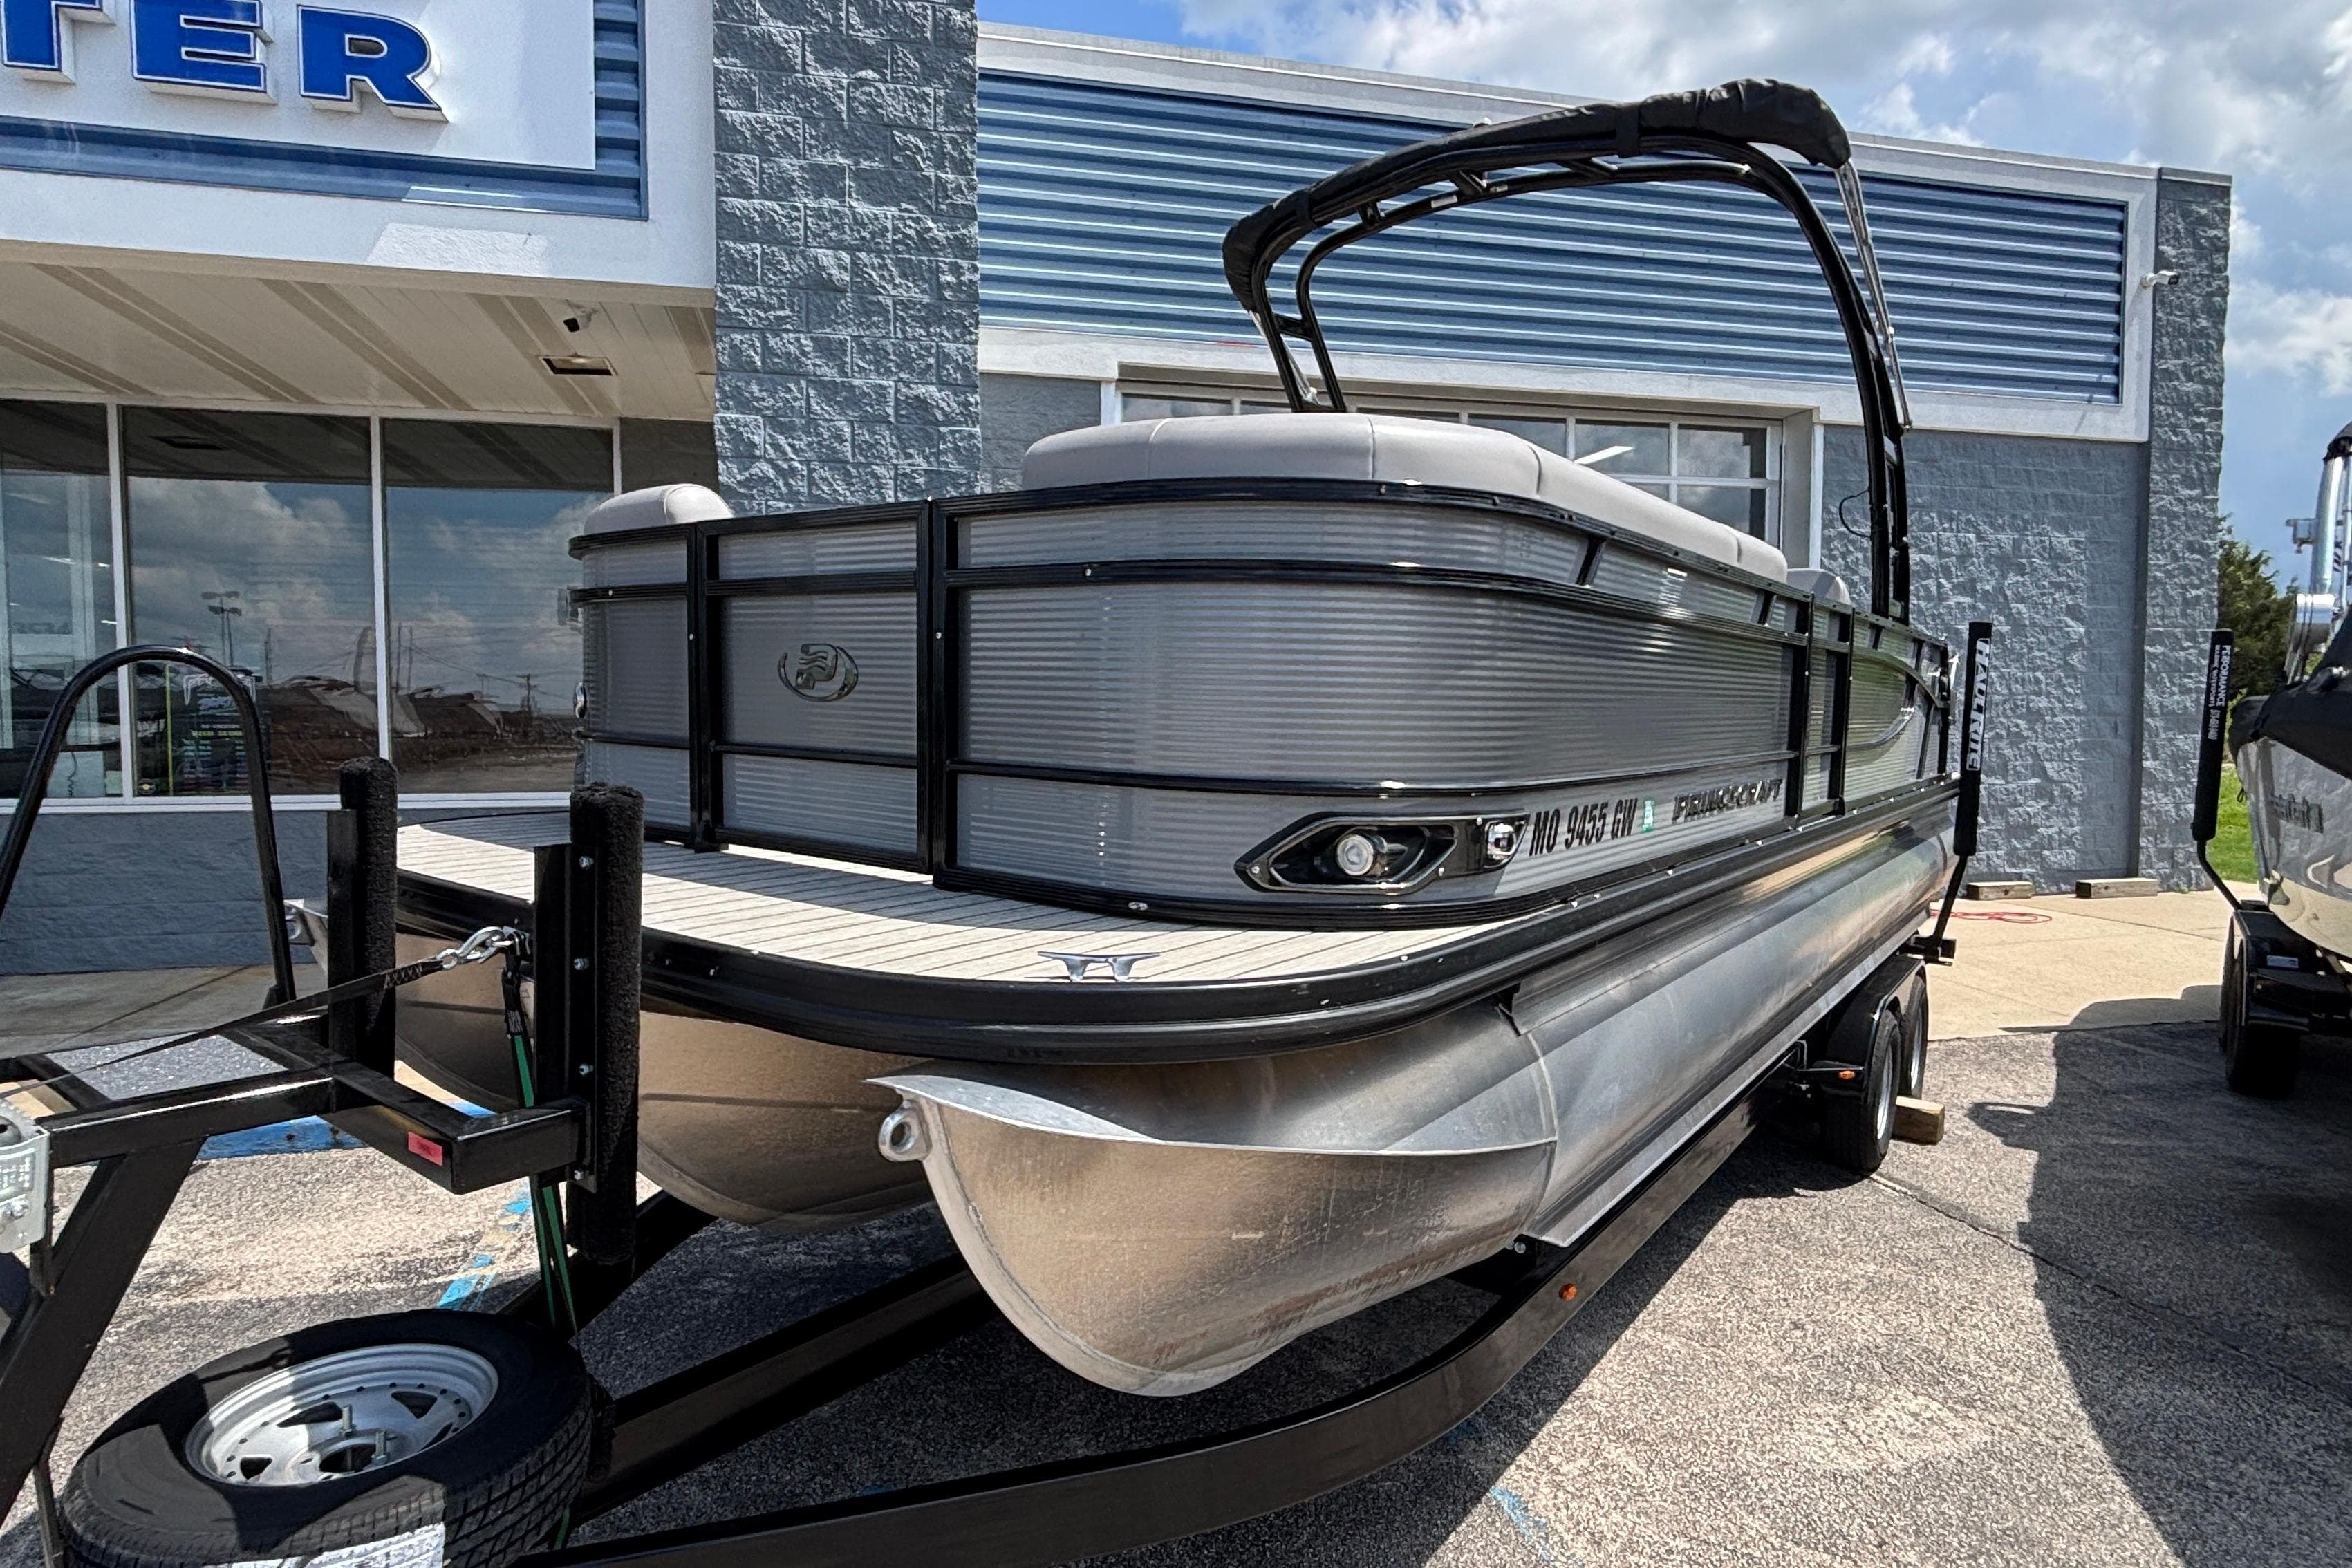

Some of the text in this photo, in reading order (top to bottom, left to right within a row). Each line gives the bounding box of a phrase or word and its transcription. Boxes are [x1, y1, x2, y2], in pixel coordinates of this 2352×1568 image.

[1968, 640, 1990, 768] HAULRITE
[2216, 644, 2232, 707] PERFORMANCE
[1529, 808, 1561, 857] MO
[1565, 802, 1609, 850] 9455
[1611, 797, 1639, 840] GW
